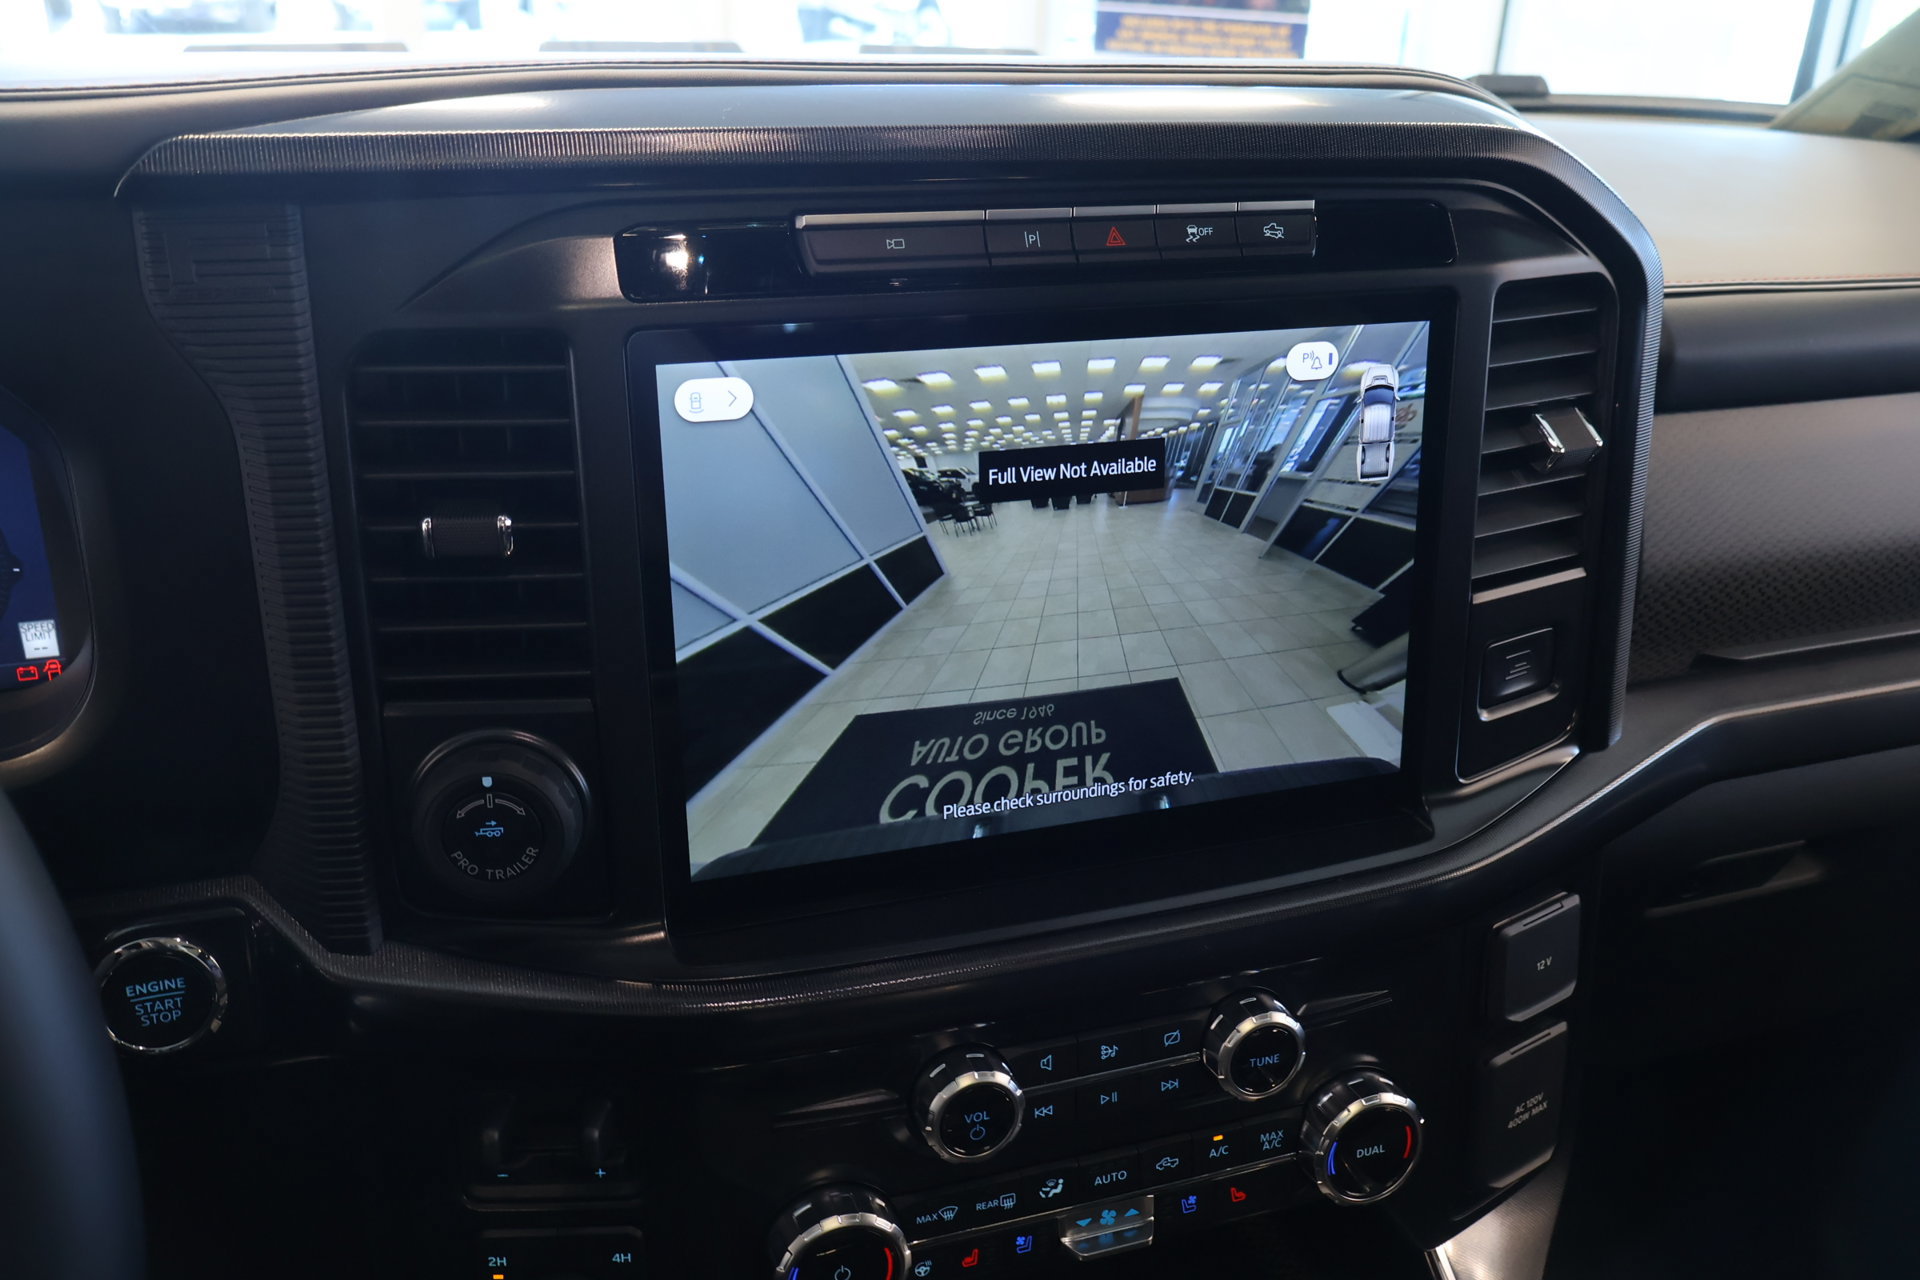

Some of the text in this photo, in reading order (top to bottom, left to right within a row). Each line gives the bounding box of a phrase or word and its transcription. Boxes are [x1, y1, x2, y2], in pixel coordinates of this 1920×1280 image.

[1198, 227, 1214, 237] OFF
[988, 456, 1157, 485] Full View Not Available
[20, 621, 55, 633] SPEED
[24, 631, 51, 642] LIMIT
[943, 770, 1195, 820] Please check surroundings for safety.
[451, 846, 540, 880] PRO TRAILER
[126, 978, 186, 997] ENGINE
[135, 997, 183, 1015] START
[141, 1010, 181, 1026] STOP
[1250, 1053, 1280, 1067] TUNE
[1514, 1102, 1526, 1115] AC
[1531, 1100, 1549, 1117] MAX
[964, 1111, 991, 1124] VOL
[1260, 1130, 1284, 1142] MAX
[1262, 1138, 1282, 1150] A/C
[1209, 1145, 1229, 1158] A/C
[1356, 1144, 1386, 1158] DUAL
[1094, 1170, 1128, 1186] AUTO
[975, 1198, 999, 1211] REAR
[916, 1213, 938, 1225] MAX
[488, 1257, 507, 1267] 2H
[612, 1253, 631, 1263] 4H
